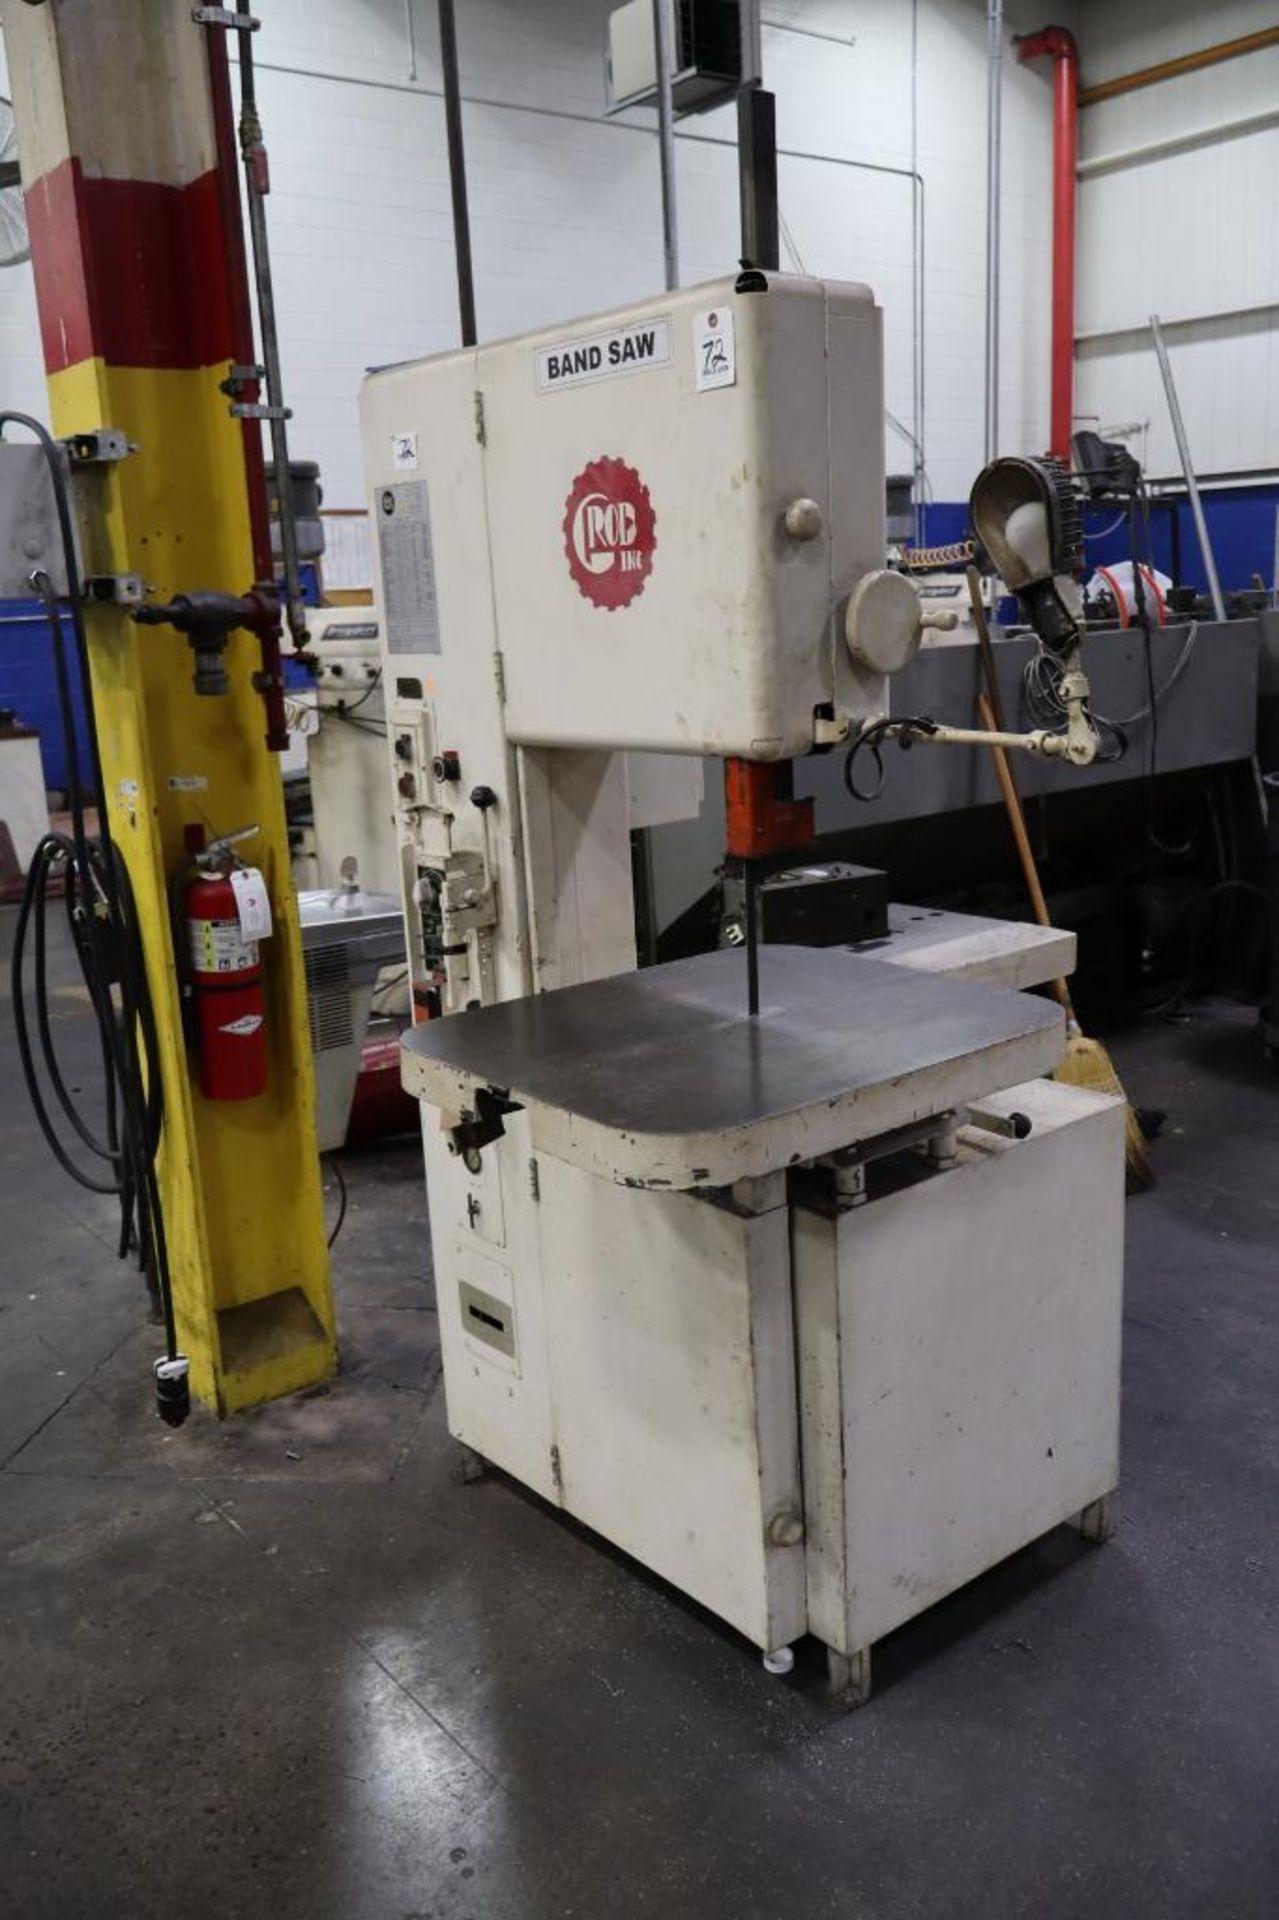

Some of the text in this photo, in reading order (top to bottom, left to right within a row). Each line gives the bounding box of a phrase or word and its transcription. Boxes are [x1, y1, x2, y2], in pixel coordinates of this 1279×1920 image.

[547, 331, 655, 379] BAND SAW
[702, 338, 727, 374] 72
[620, 550, 643, 572] INC
